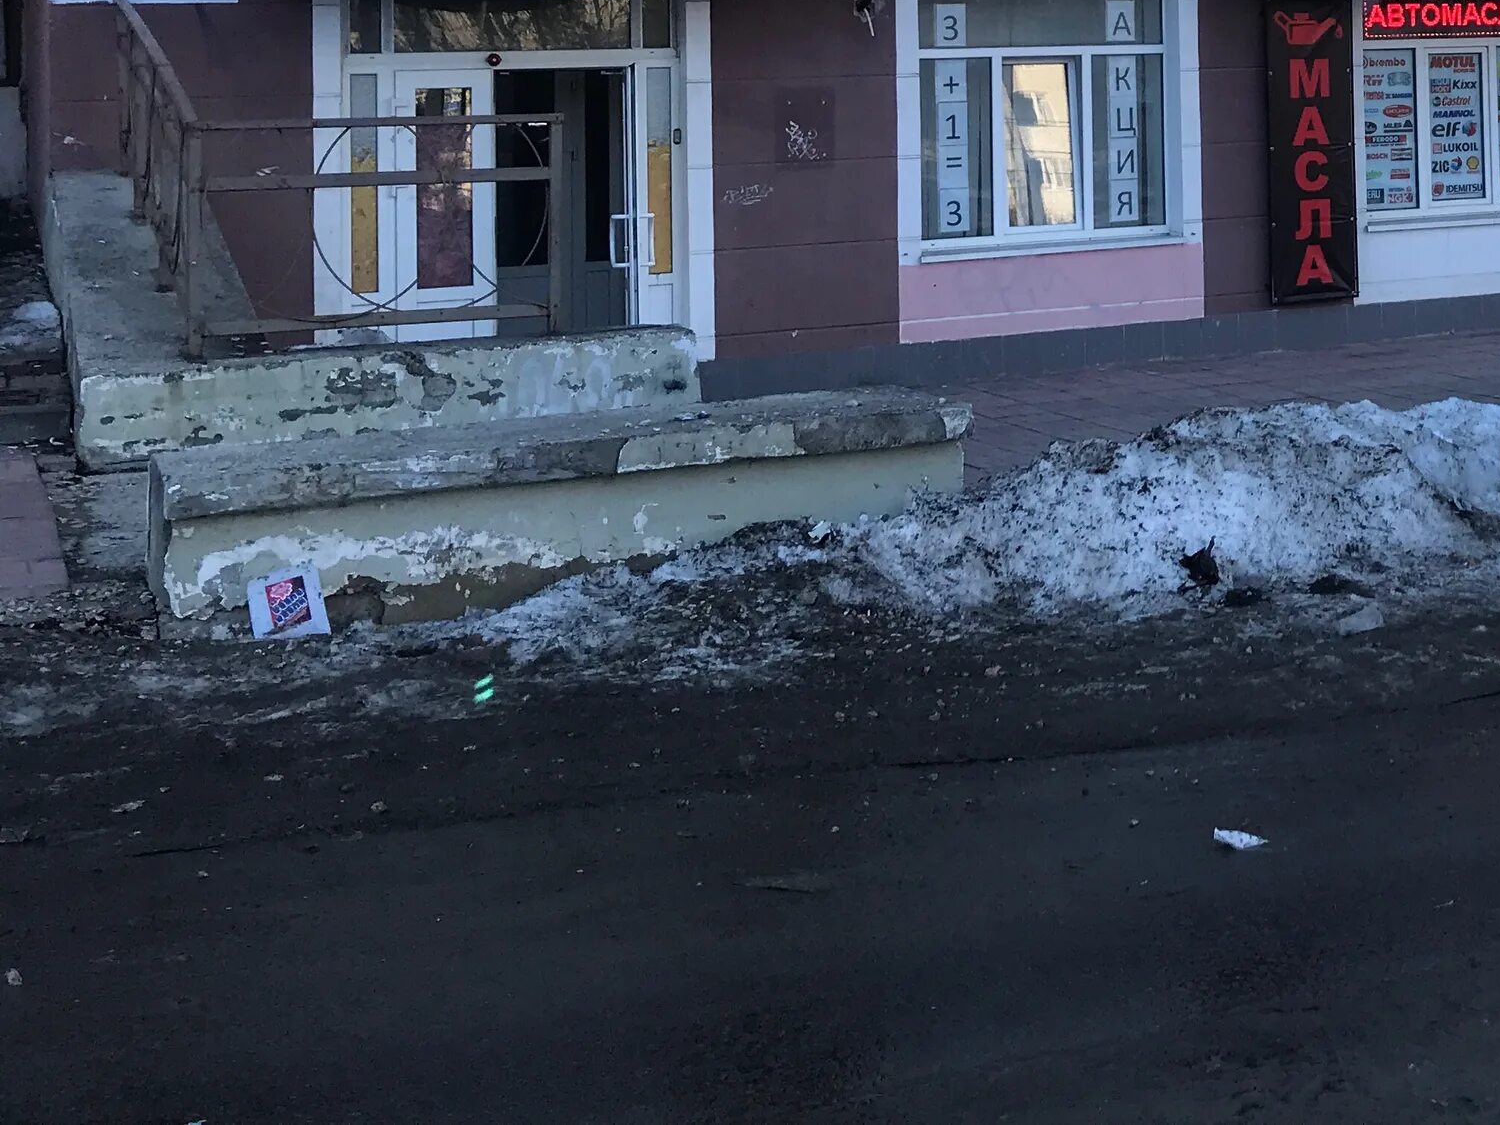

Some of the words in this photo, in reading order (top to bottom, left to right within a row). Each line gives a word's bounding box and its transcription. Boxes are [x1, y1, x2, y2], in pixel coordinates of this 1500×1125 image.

[1369, 56, 1406, 67] brembo
[1430, 55, 1475, 69] MOTUL
[1453, 79, 1477, 90] Kixx
[1442, 96, 1471, 106] Castrol
[1111, 10, 1139, 217] АКЦИЯ
[1432, 110, 1475, 118] MANNOL
[1432, 122, 1461, 137] elf
[1443, 142, 1478, 153] LUKOIL
[1288, 57, 1335, 287] МАСЛА
[1432, 161, 1449, 173] ZIC
[1446, 183, 1483, 193] IDEMITSU
